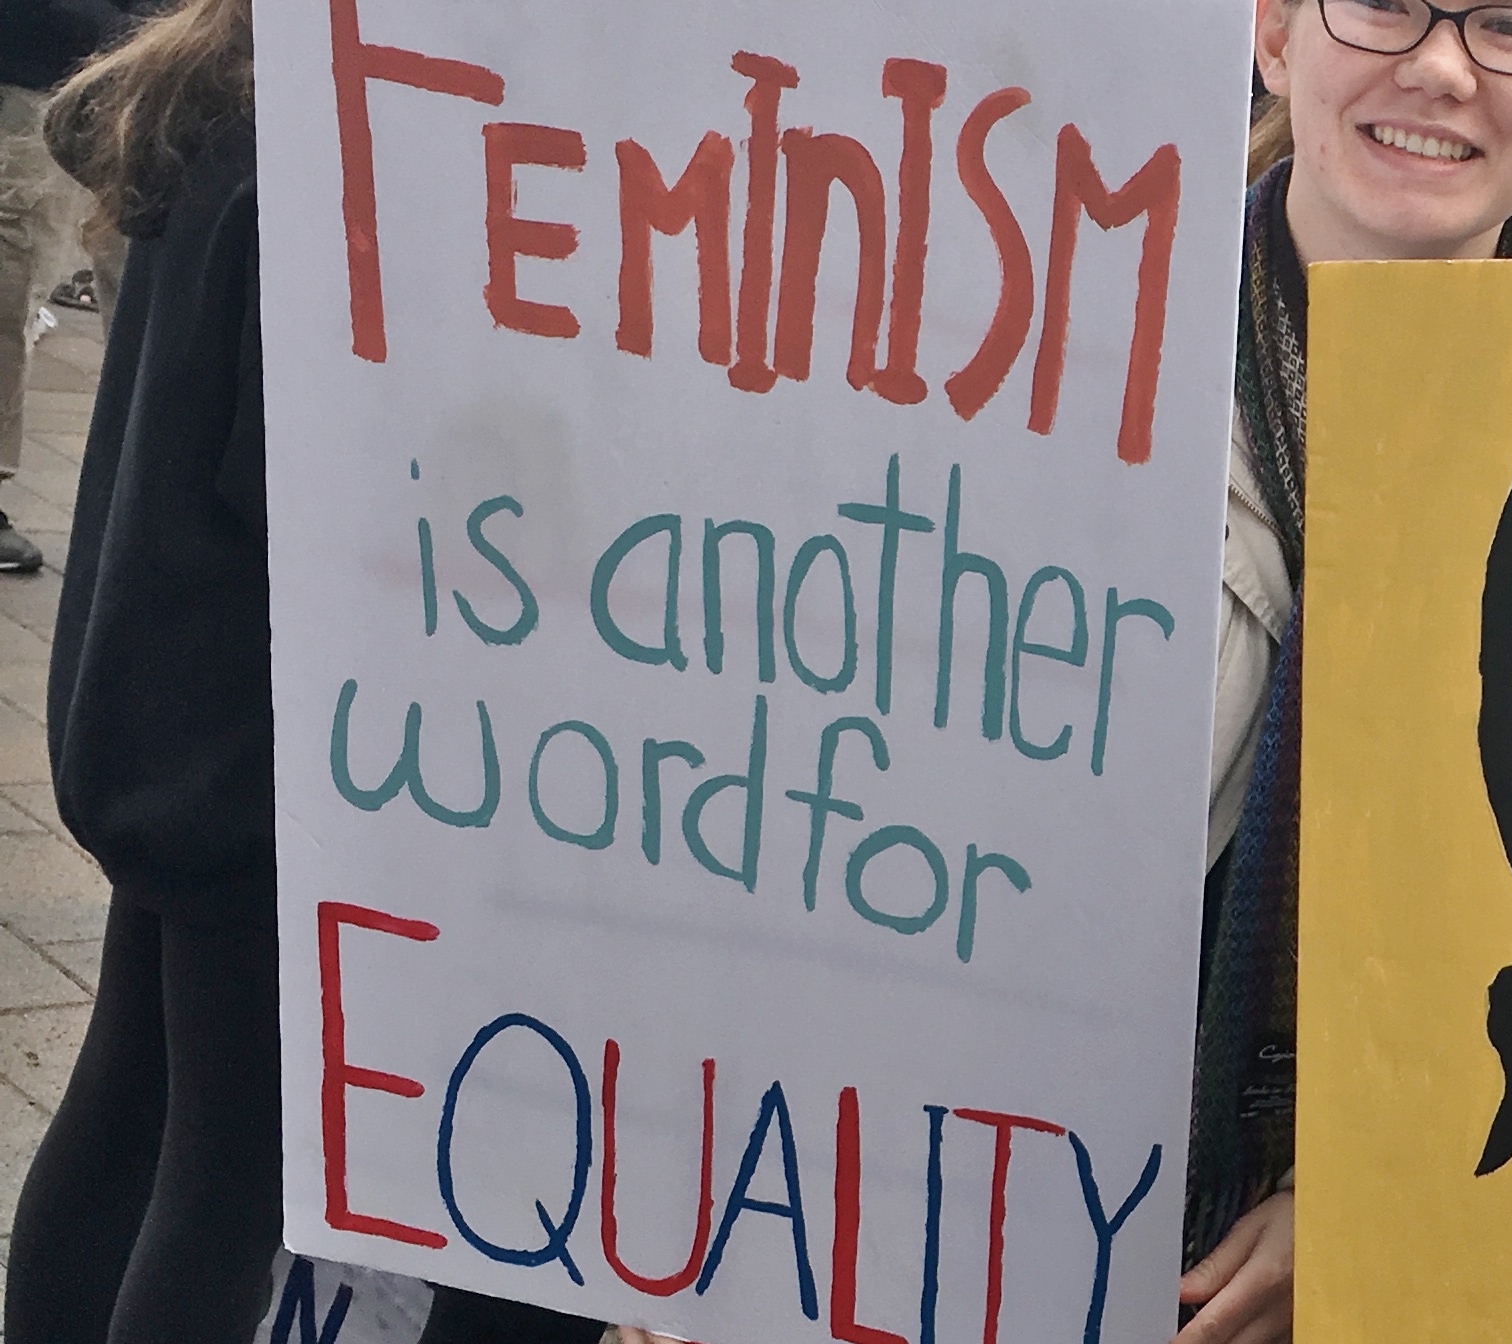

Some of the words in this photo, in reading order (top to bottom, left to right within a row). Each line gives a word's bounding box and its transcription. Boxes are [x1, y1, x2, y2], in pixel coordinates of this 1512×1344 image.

[409, 460, 539, 645] is
[591, 452, 1174, 777] another
[330, 678, 767, 892] word
[786, 716, 1032, 962] for
